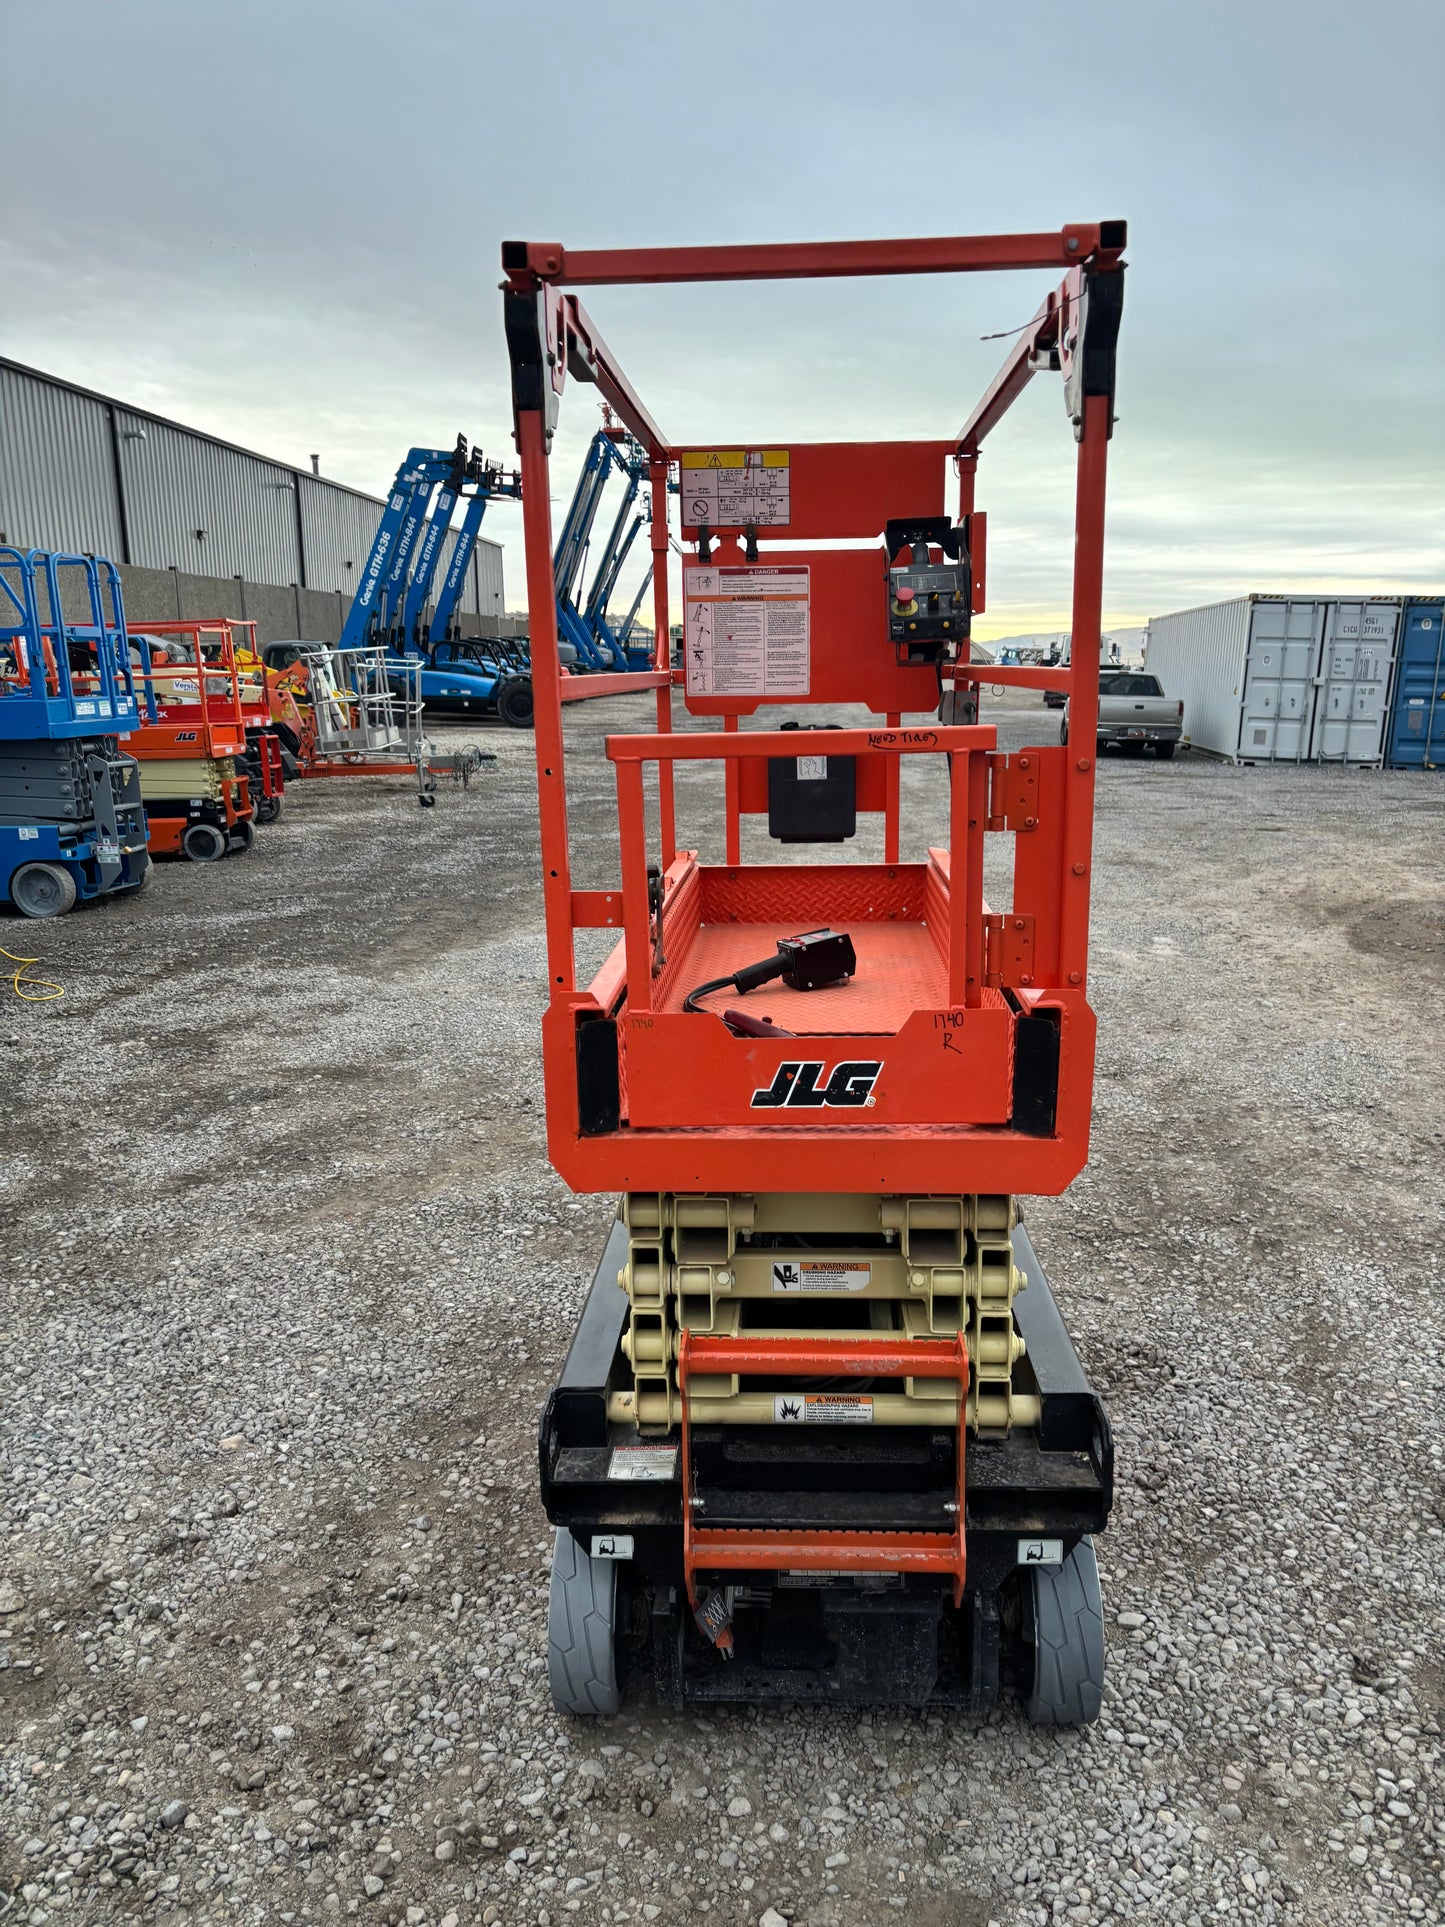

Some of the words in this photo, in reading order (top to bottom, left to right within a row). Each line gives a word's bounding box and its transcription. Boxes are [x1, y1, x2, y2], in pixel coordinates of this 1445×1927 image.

[391, 558, 404, 581] Genie
[399, 516, 417, 556] GTH-844
[416, 562, 428, 584] Genie
[422, 524, 440, 560] GTH-844
[448, 567, 459, 588] Genie
[456, 532, 470, 566] GTH-844
[360, 579, 376, 606] Genie
[370, 531, 391, 578] GTH-636
[1363, 626, 1384, 634] 371931
[175, 732, 197, 742] JLG
[632, 1018, 654, 1029] 1740
[934, 1011, 964, 1029] 1740
[942, 1032, 962, 1054] R
[750, 1060, 884, 1108] JLG
